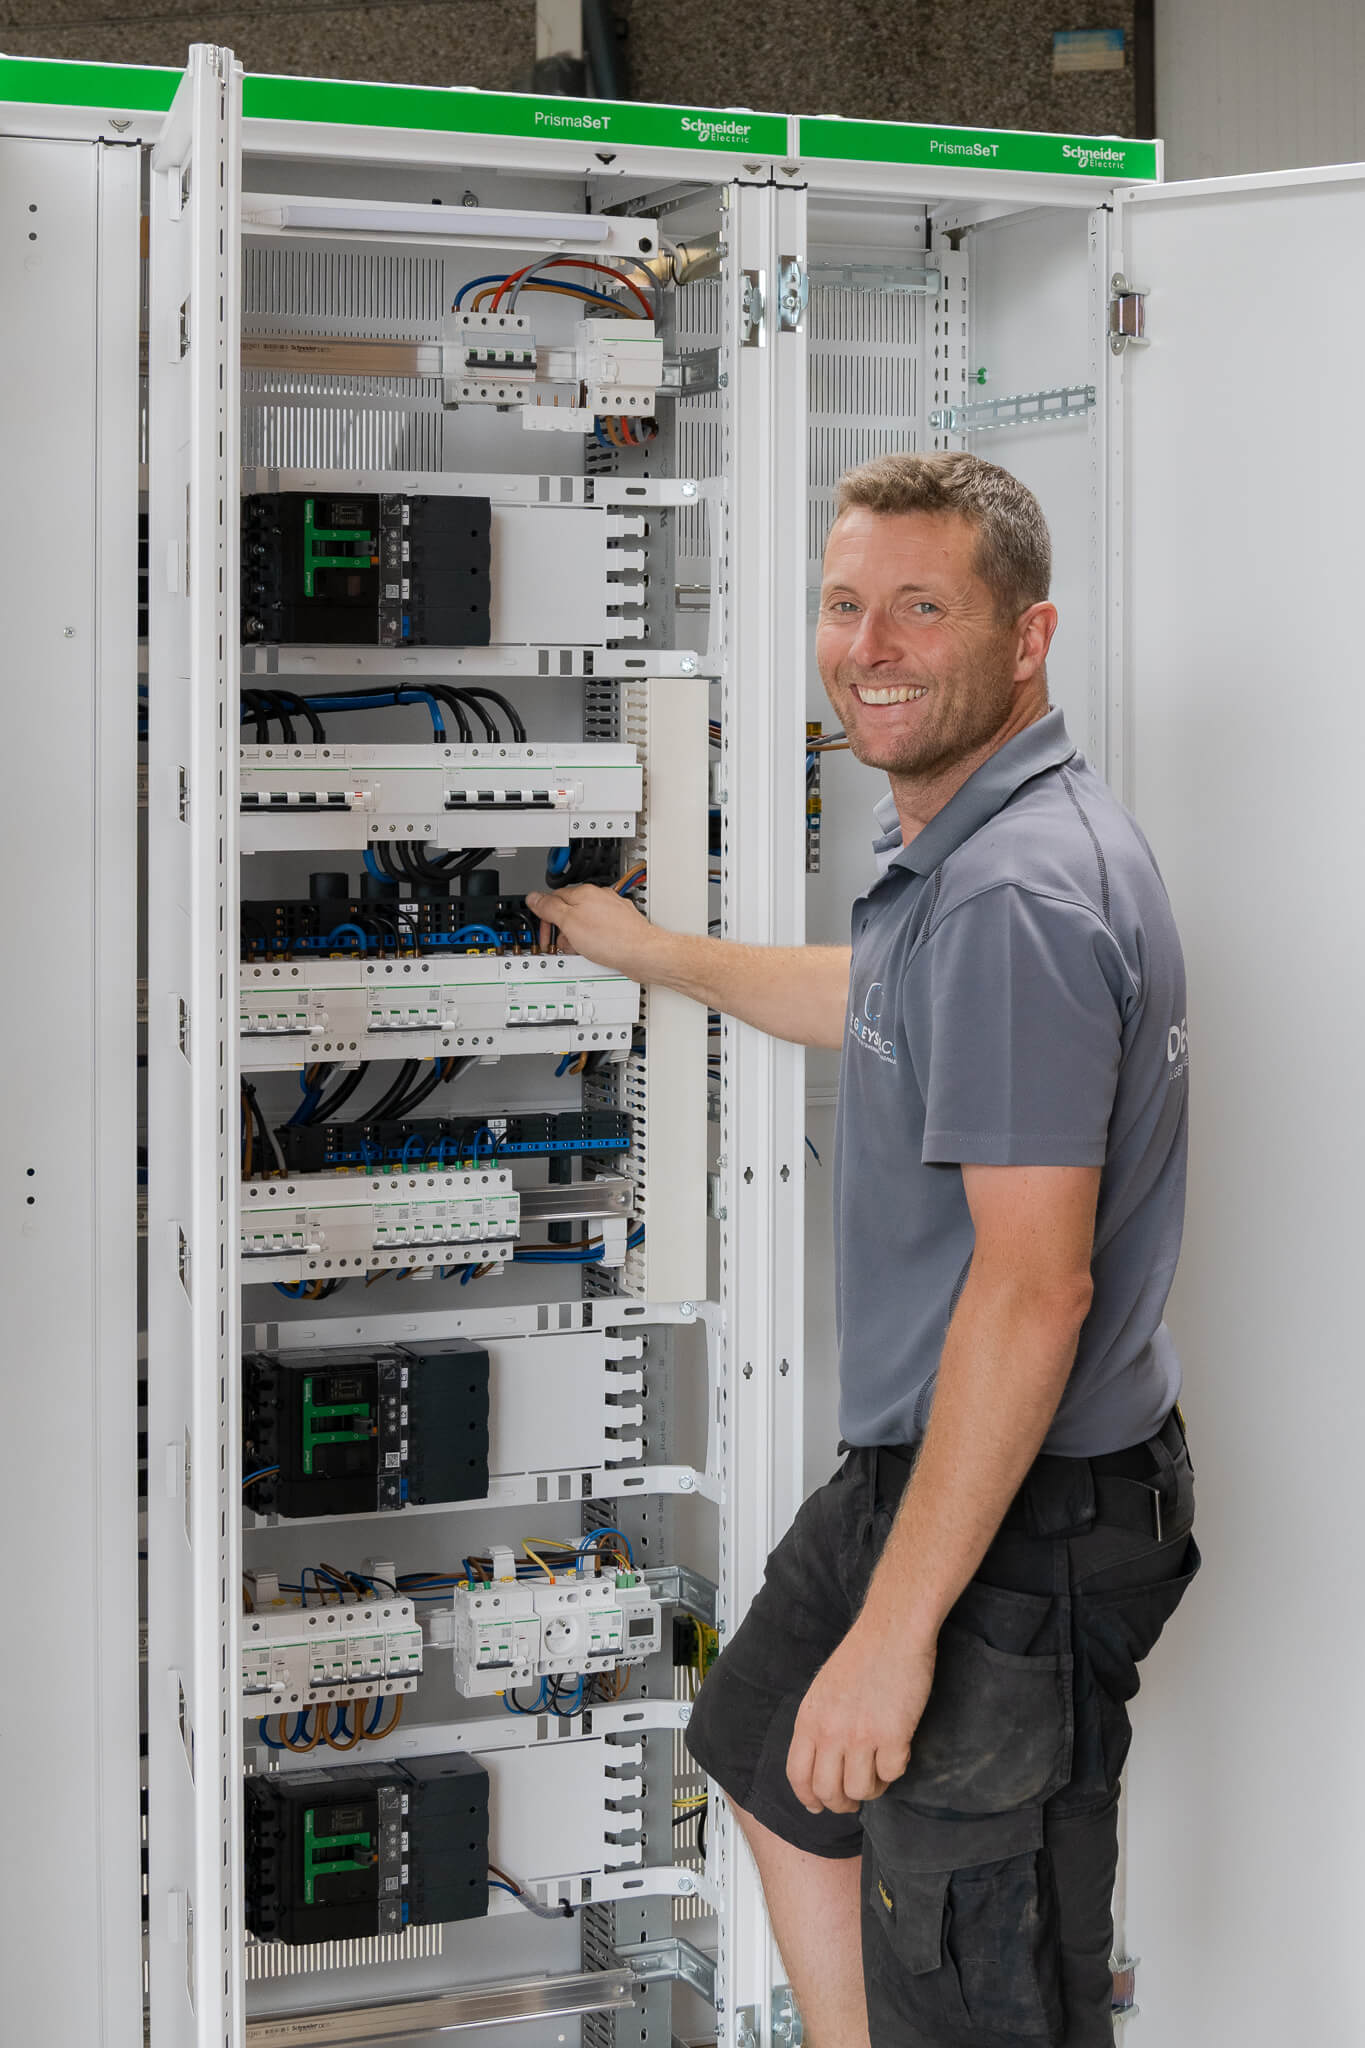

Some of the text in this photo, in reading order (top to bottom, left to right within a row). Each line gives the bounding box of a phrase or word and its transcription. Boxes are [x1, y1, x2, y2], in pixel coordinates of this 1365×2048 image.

[534, 111, 611, 129] PrismaSeT
[680, 116, 751, 136] Schneider
[711, 133, 750, 144] Electric
[930, 140, 999, 157] PrismaSeT
[1062, 145, 1126, 161] Schneider
[1089, 160, 1125, 169] Electric
